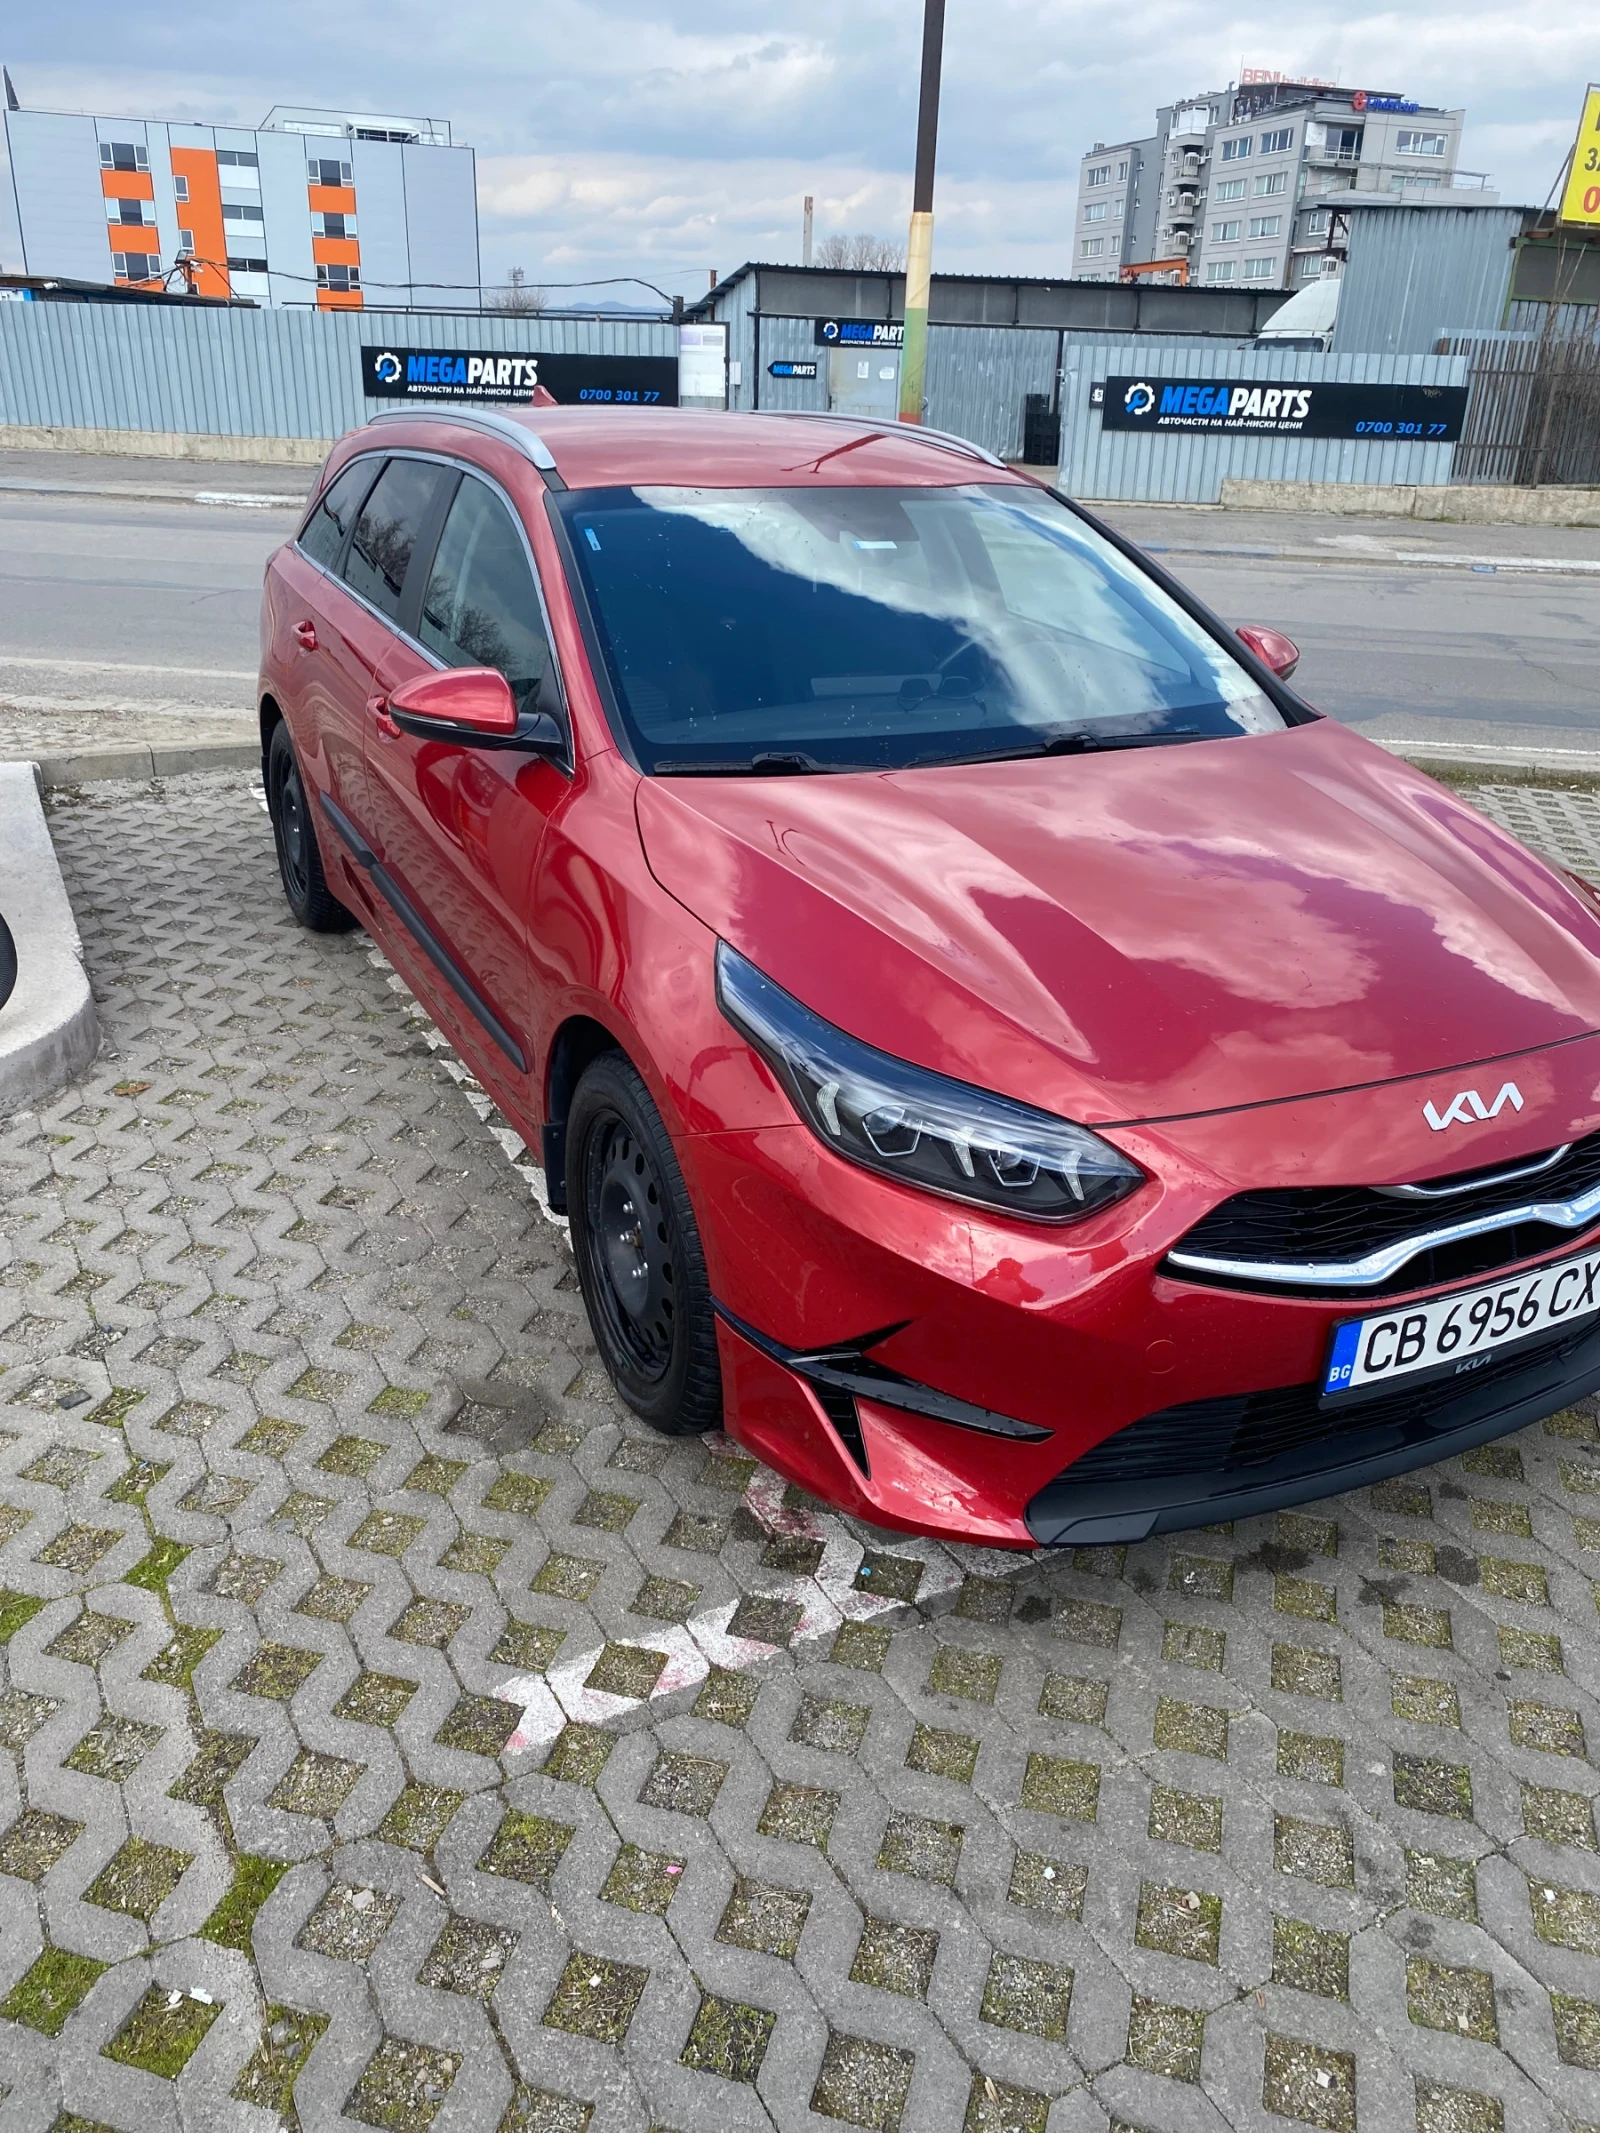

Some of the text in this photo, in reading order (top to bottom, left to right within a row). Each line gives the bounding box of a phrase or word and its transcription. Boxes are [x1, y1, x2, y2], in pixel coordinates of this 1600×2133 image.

[407, 356, 538, 386] MEGAPARTS
[773, 364, 816, 375] MEGAPARTS
[407, 385, 534, 397] АВТОЧАСТИ НА НАЙ-НИСКИ ЦЕНИ
[579, 389, 660, 402] 0700 301 77
[1159, 386, 1313, 418] MEGAPARTS
[1157, 416, 1303, 430] АВТОЧАСТИ НА НАЙ-НИСКИ ЦЕНИ
[1355, 421, 1447, 435] 0700 301 77
[1422, 1082, 1525, 1131] KIA
[1363, 1313, 1428, 1374] CB
[1436, 1278, 1542, 1354] 6956
[1328, 1364, 1351, 1383] BG
[1455, 1354, 1492, 1375] KIA
